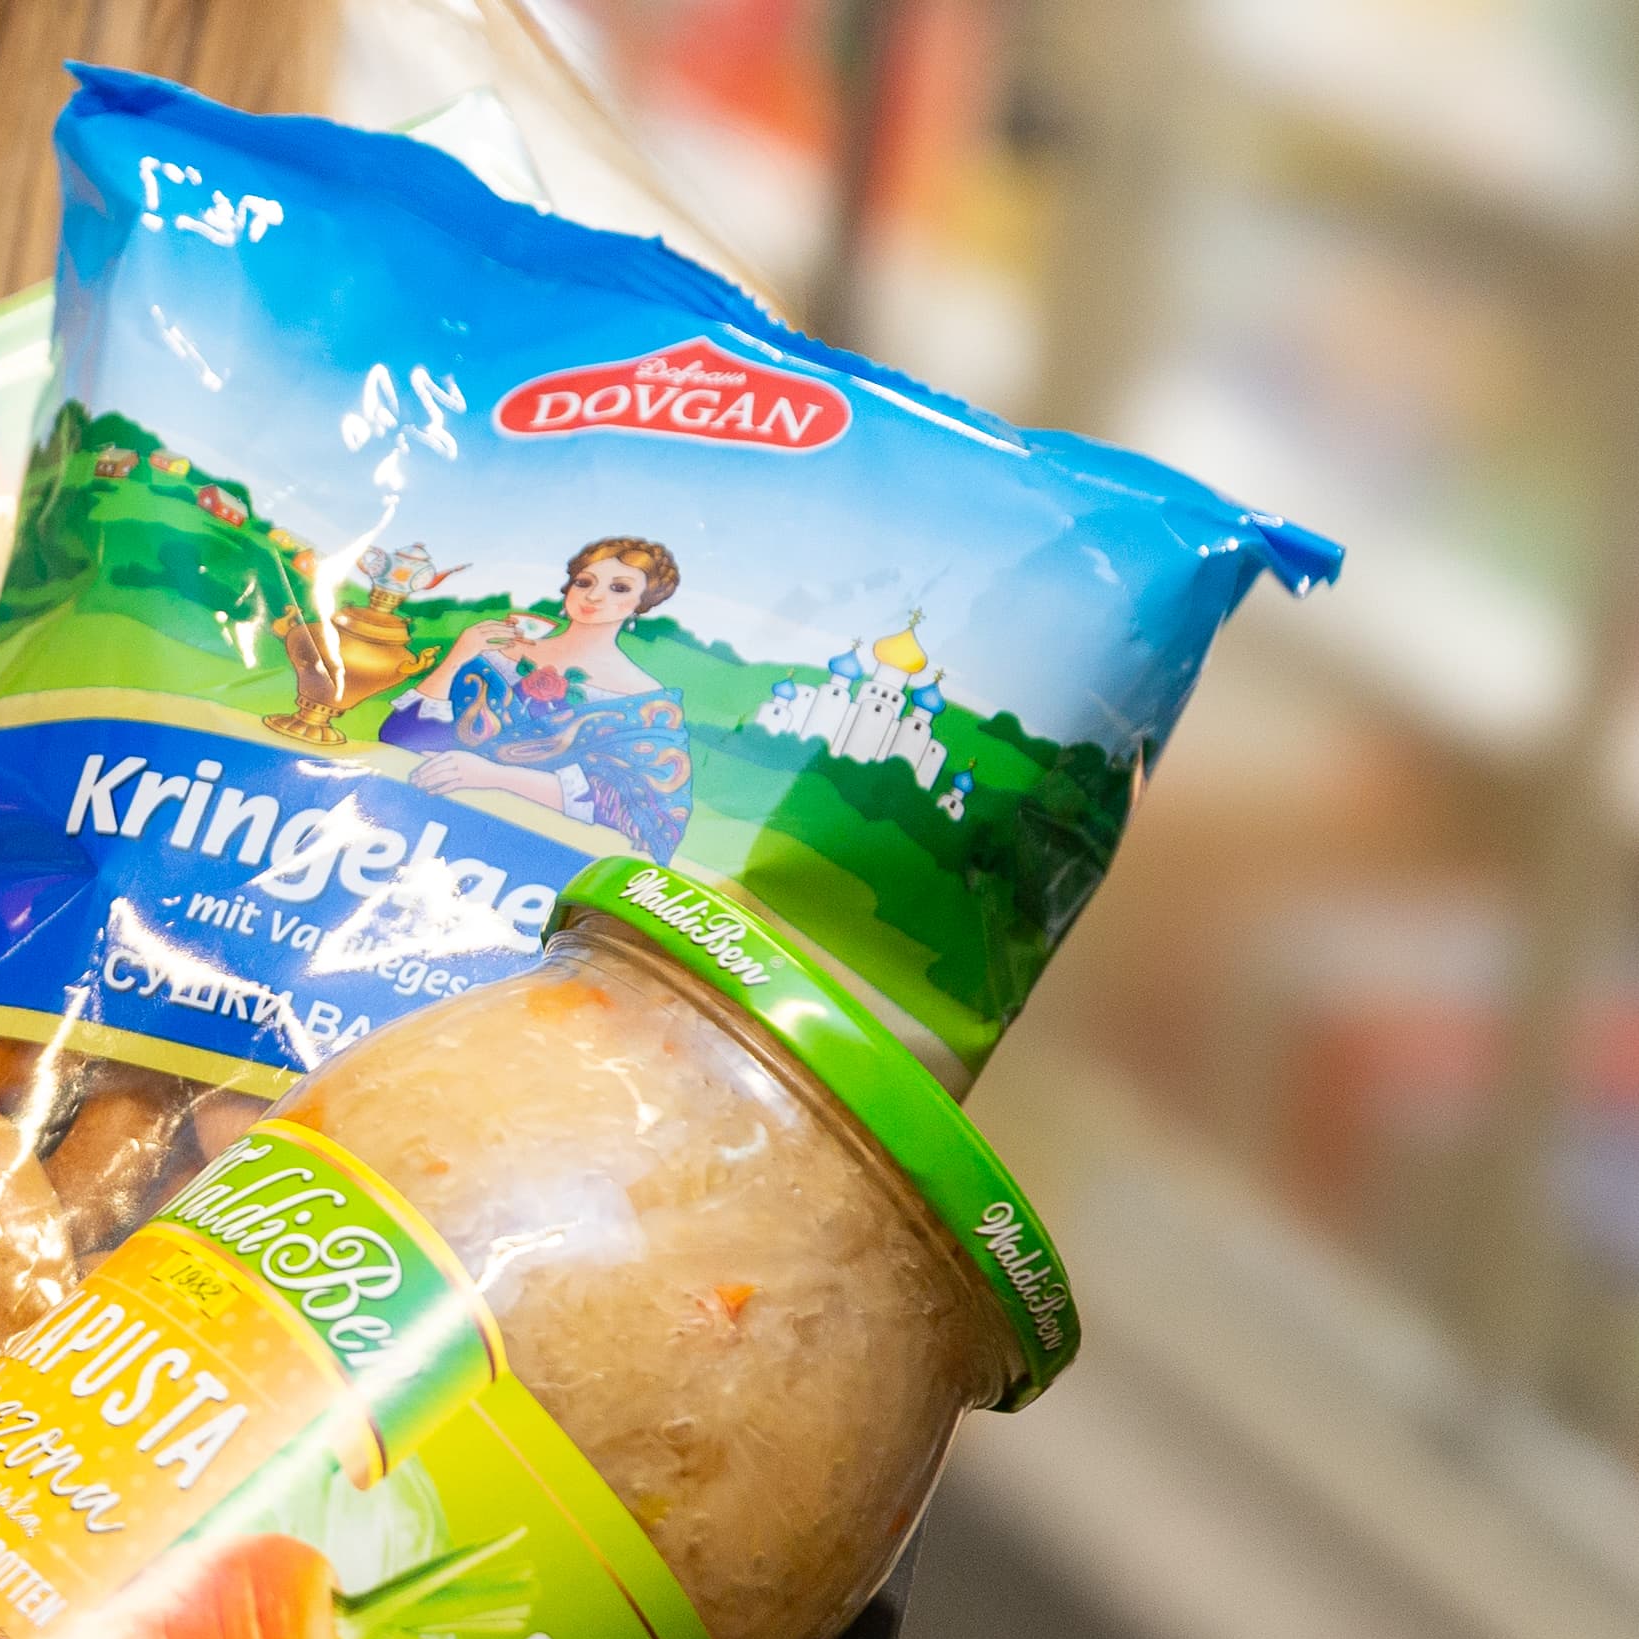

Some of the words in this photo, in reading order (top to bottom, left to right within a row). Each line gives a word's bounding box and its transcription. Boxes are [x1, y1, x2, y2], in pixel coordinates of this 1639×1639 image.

[531, 384, 822, 442] DOVGAN
[186, 890, 268, 936] mit
[618, 868, 773, 989] WaldiBen
[170, 1264, 223, 1301] 1982
[973, 1201, 1066, 1353] WaldiBen
